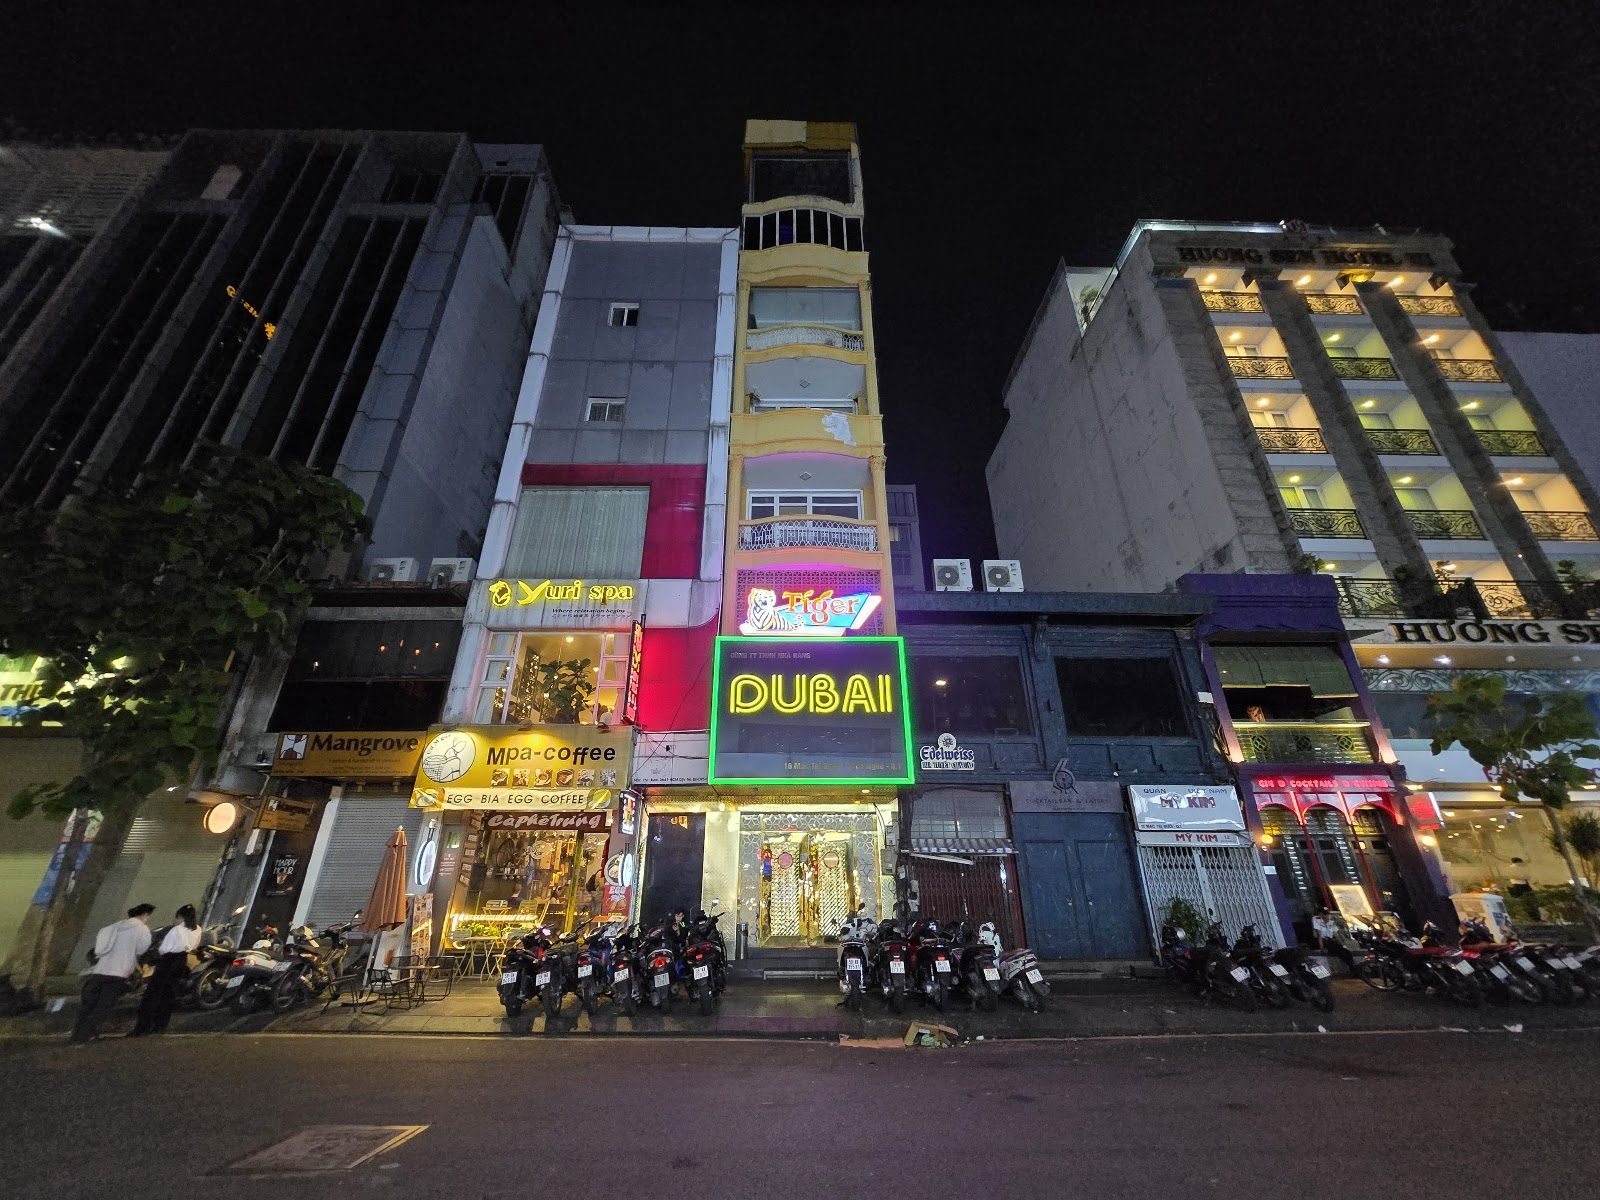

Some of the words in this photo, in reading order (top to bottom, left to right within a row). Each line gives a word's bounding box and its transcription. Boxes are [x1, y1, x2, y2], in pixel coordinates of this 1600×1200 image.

[517, 579, 582, 605] Yuri
[589, 584, 634, 606] spa
[781, 590, 860, 624] Tiger
[729, 673, 893, 713] DUBAI
[310, 734, 419, 756] Mangrove
[921, 745, 974, 760] Edelweiss
[487, 746, 616, 766] Mpa-coffee
[1290, 779, 1338, 788] COCKTAILS
[446, 794, 473, 804] EGG
[480, 794, 499, 804] BIA
[507, 794, 534, 804] EGG
[541, 794, 584, 804] COFFEE
[1187, 796, 1216, 808] KIM
[1196, 834, 1218, 842] KIM
